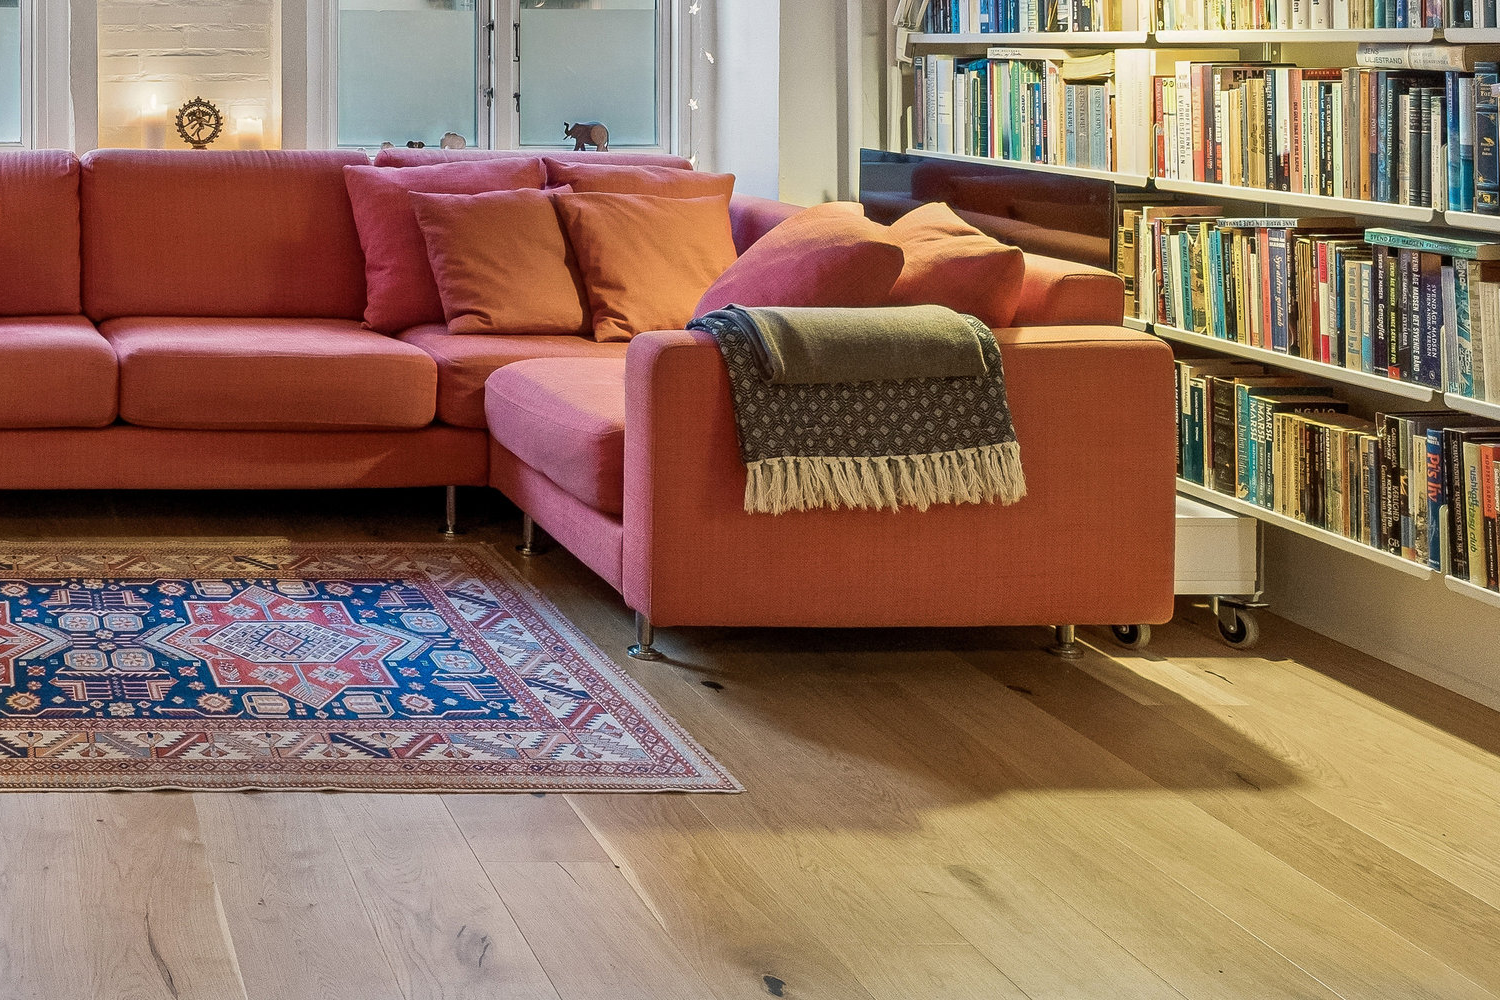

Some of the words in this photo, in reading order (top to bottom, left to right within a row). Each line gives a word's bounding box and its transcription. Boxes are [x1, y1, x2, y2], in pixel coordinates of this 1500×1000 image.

[1427, 453, 1440, 479] Pi's
[1427, 482, 1441, 503] liv
[1469, 465, 1479, 507] rushkoff
